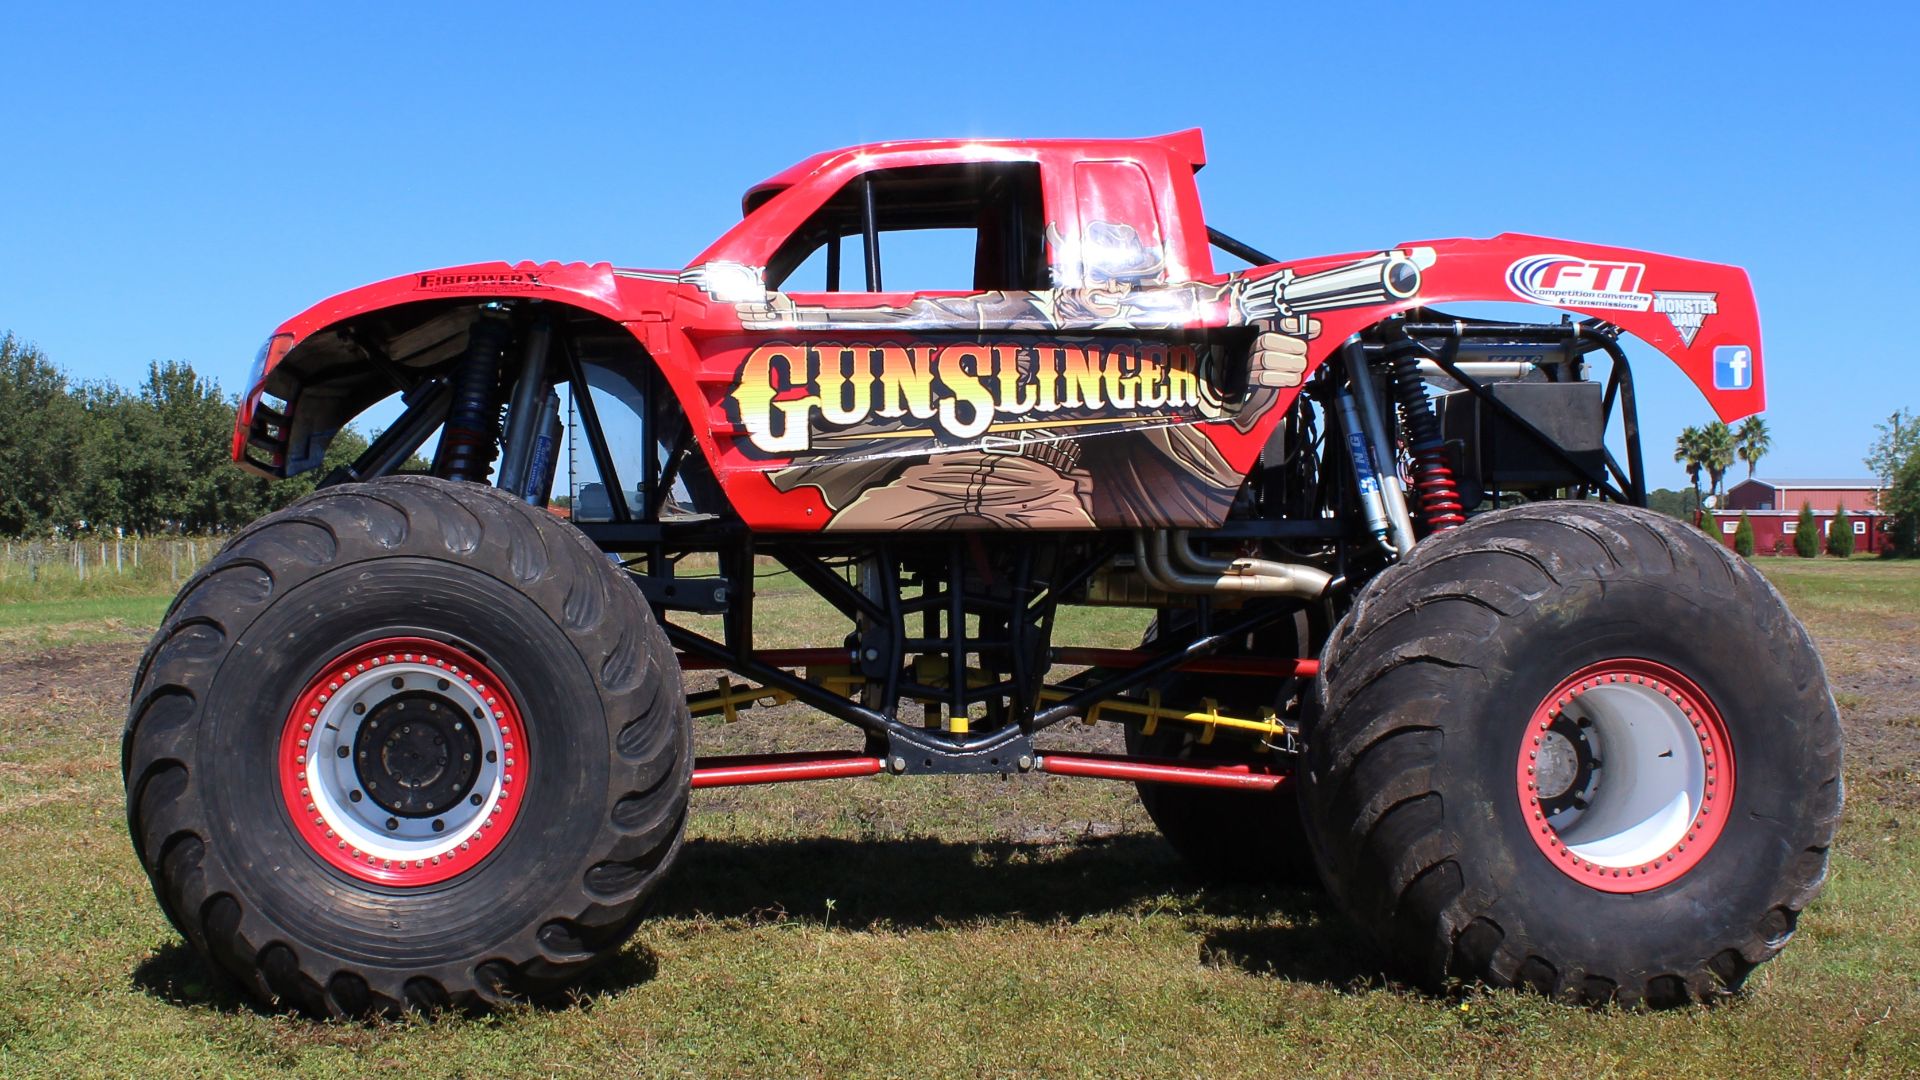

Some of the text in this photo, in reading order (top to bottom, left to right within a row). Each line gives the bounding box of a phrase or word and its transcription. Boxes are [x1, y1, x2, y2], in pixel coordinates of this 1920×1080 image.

[1539, 261, 1641, 292] FTI
[1533, 289, 1649, 302] competition converters
[1569, 298, 1639, 309] transmissions
[1653, 298, 1718, 314] MONSTER
[1673, 313, 1702, 328] JAM
[729, 340, 1199, 453] GUNSLINGER
